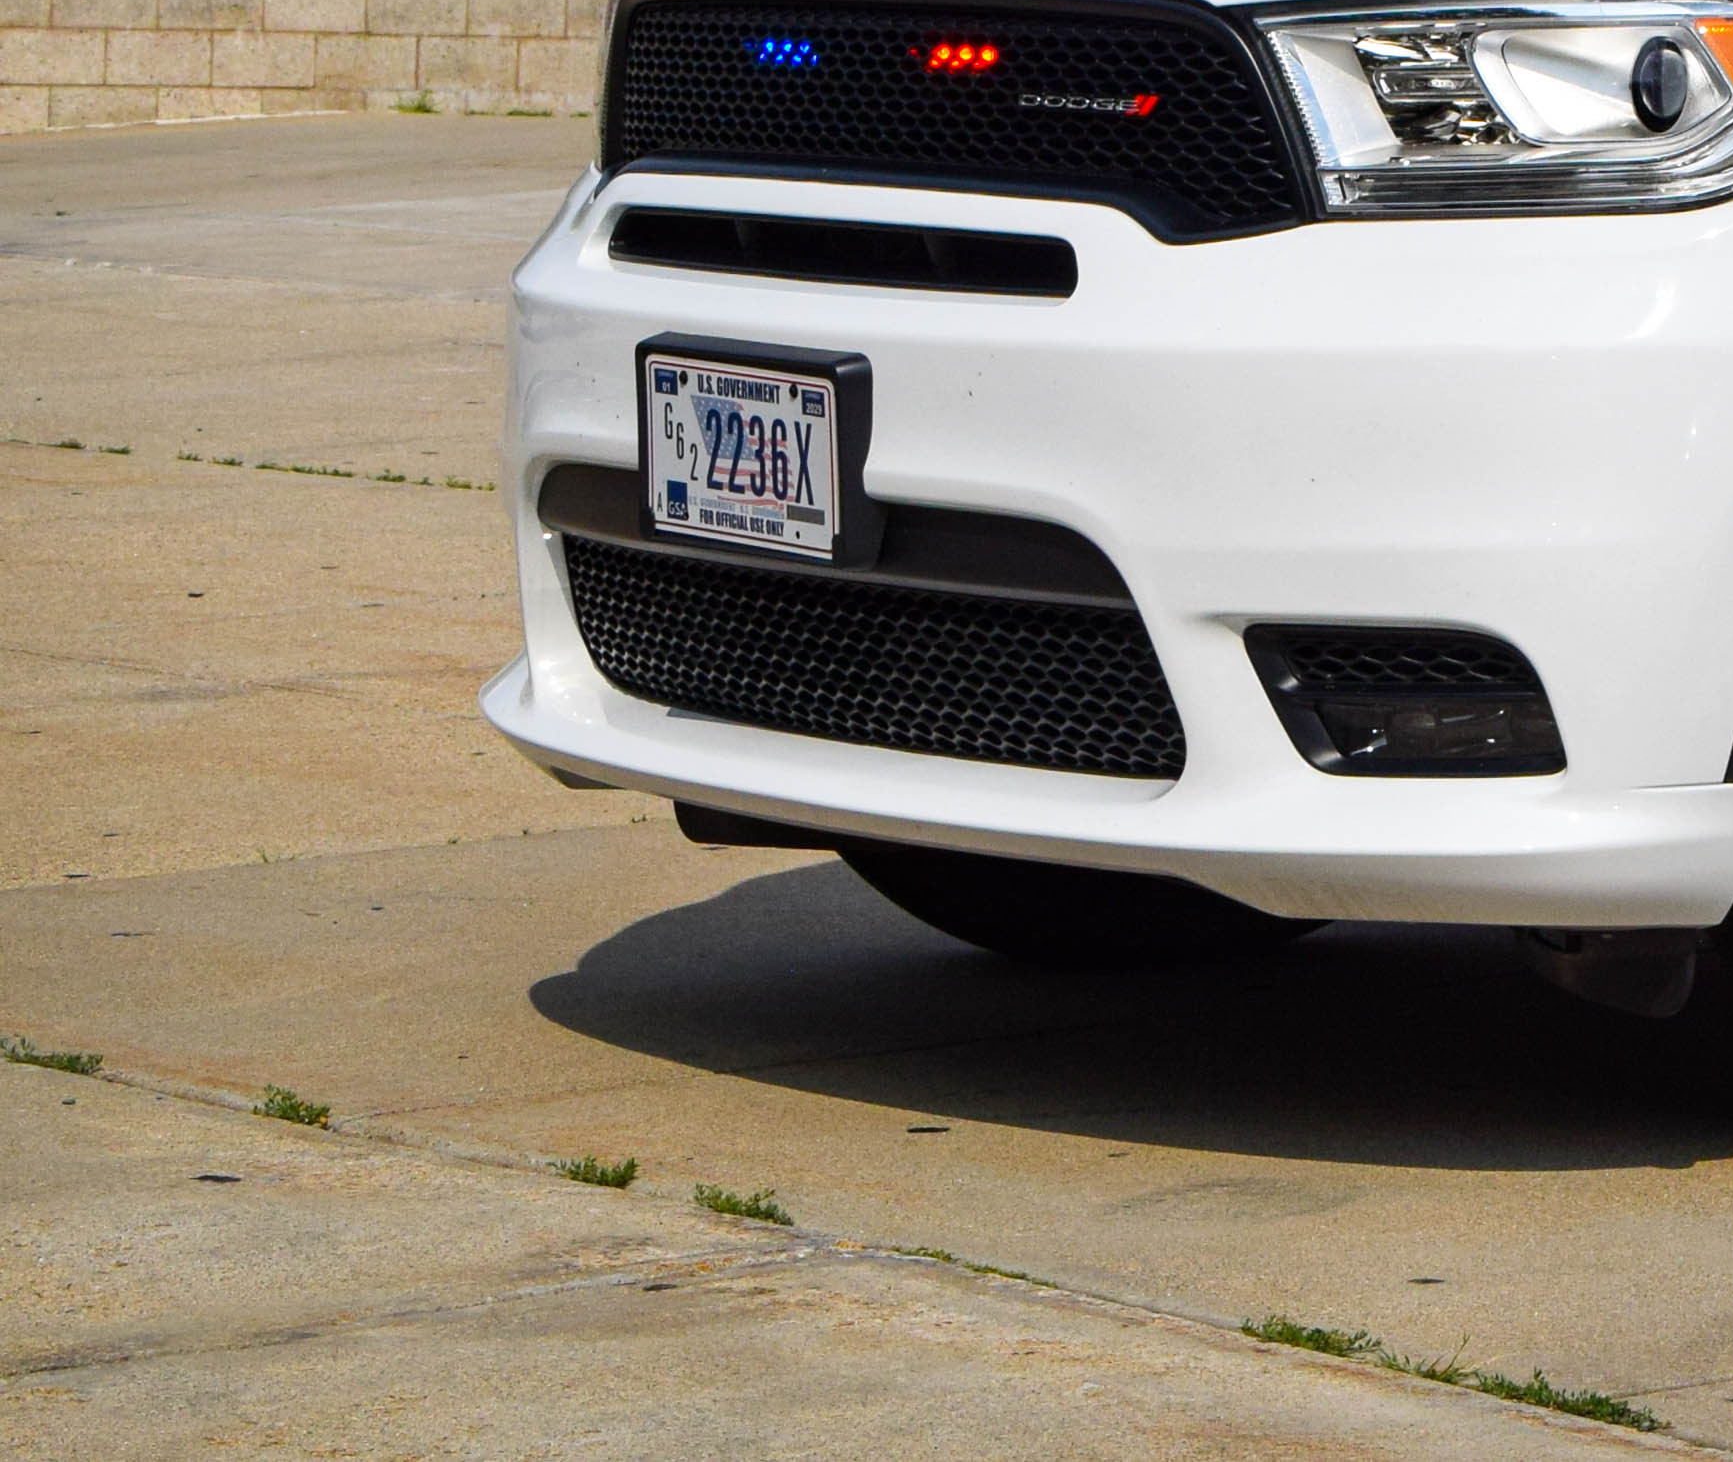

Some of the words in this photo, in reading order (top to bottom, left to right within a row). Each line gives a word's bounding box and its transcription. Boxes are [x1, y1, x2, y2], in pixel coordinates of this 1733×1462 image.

[1020, 94, 1139, 111] DODGE
[697, 374, 715, 395] U.S.
[716, 377, 780, 404] GOVERNMENT
[706, 409, 814, 505] 2236X
[700, 508, 714, 525] FOR
[716, 511, 748, 532] OFFICIAL
[750, 517, 764, 534] USE
[766, 520, 784, 537] ONLY
